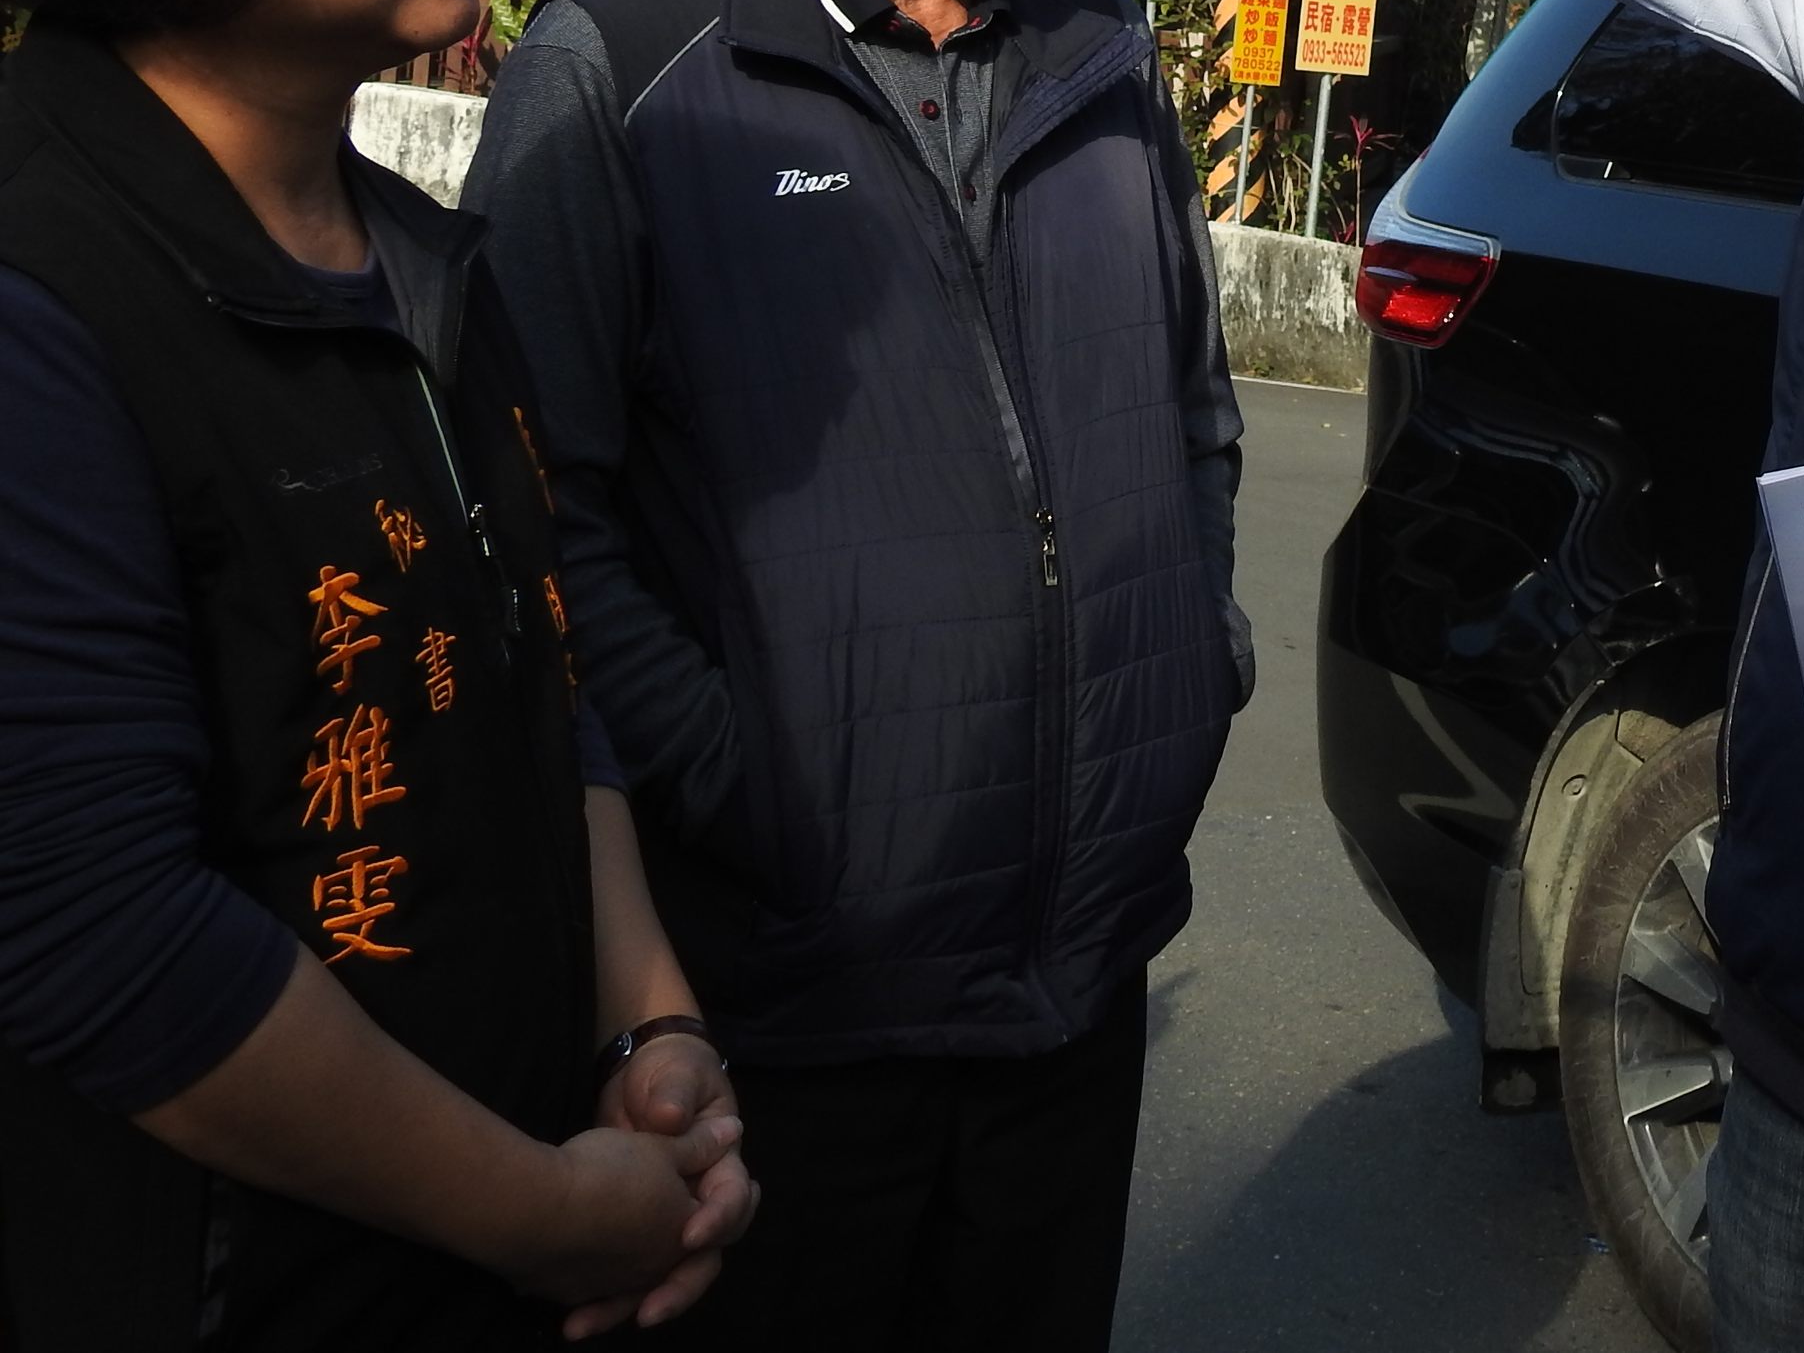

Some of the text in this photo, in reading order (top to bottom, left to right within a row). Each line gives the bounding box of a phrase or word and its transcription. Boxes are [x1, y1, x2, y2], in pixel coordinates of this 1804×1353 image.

[1234, 57, 1281, 72] 780522
[1243, 46, 1275, 59] 0937
[1302, 37, 1367, 68] 0933-565523
[775, 169, 850, 197] Dinos
[302, 565, 412, 965] 李雅雯
